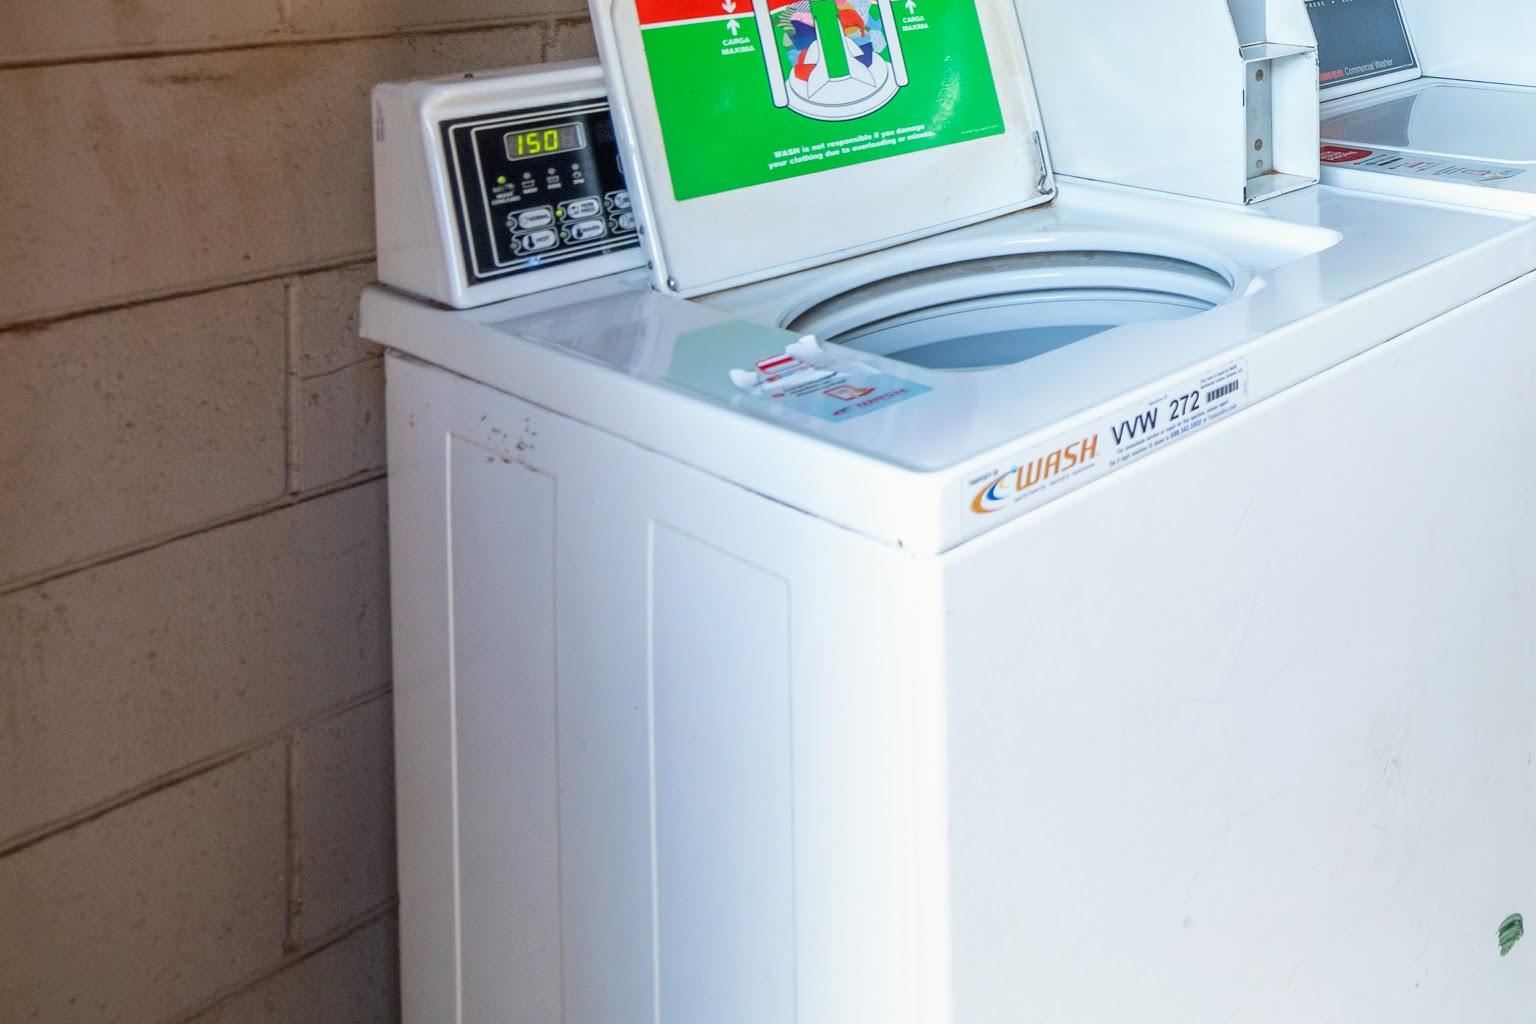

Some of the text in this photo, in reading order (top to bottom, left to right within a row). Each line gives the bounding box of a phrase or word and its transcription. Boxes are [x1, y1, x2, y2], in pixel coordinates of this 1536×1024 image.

[902, 23, 929, 32] MAXIMA
[721, 45, 756, 55] MAXIMA
[722, 37, 750, 46] CARGA
[1344, 62, 1374, 76] Commercial
[1375, 58, 1393, 69] Washer
[516, 130, 558, 156] 150
[773, 124, 925, 159] WASH is not responsible if you damage
[768, 159, 788, 170] your
[789, 153, 824, 165] clothing
[825, 149, 840, 158] due
[852, 137, 897, 152] overloading
[1016, 434, 1098, 491] WASH
[1112, 407, 1158, 445] VVW
[1169, 390, 1200, 422] 272
